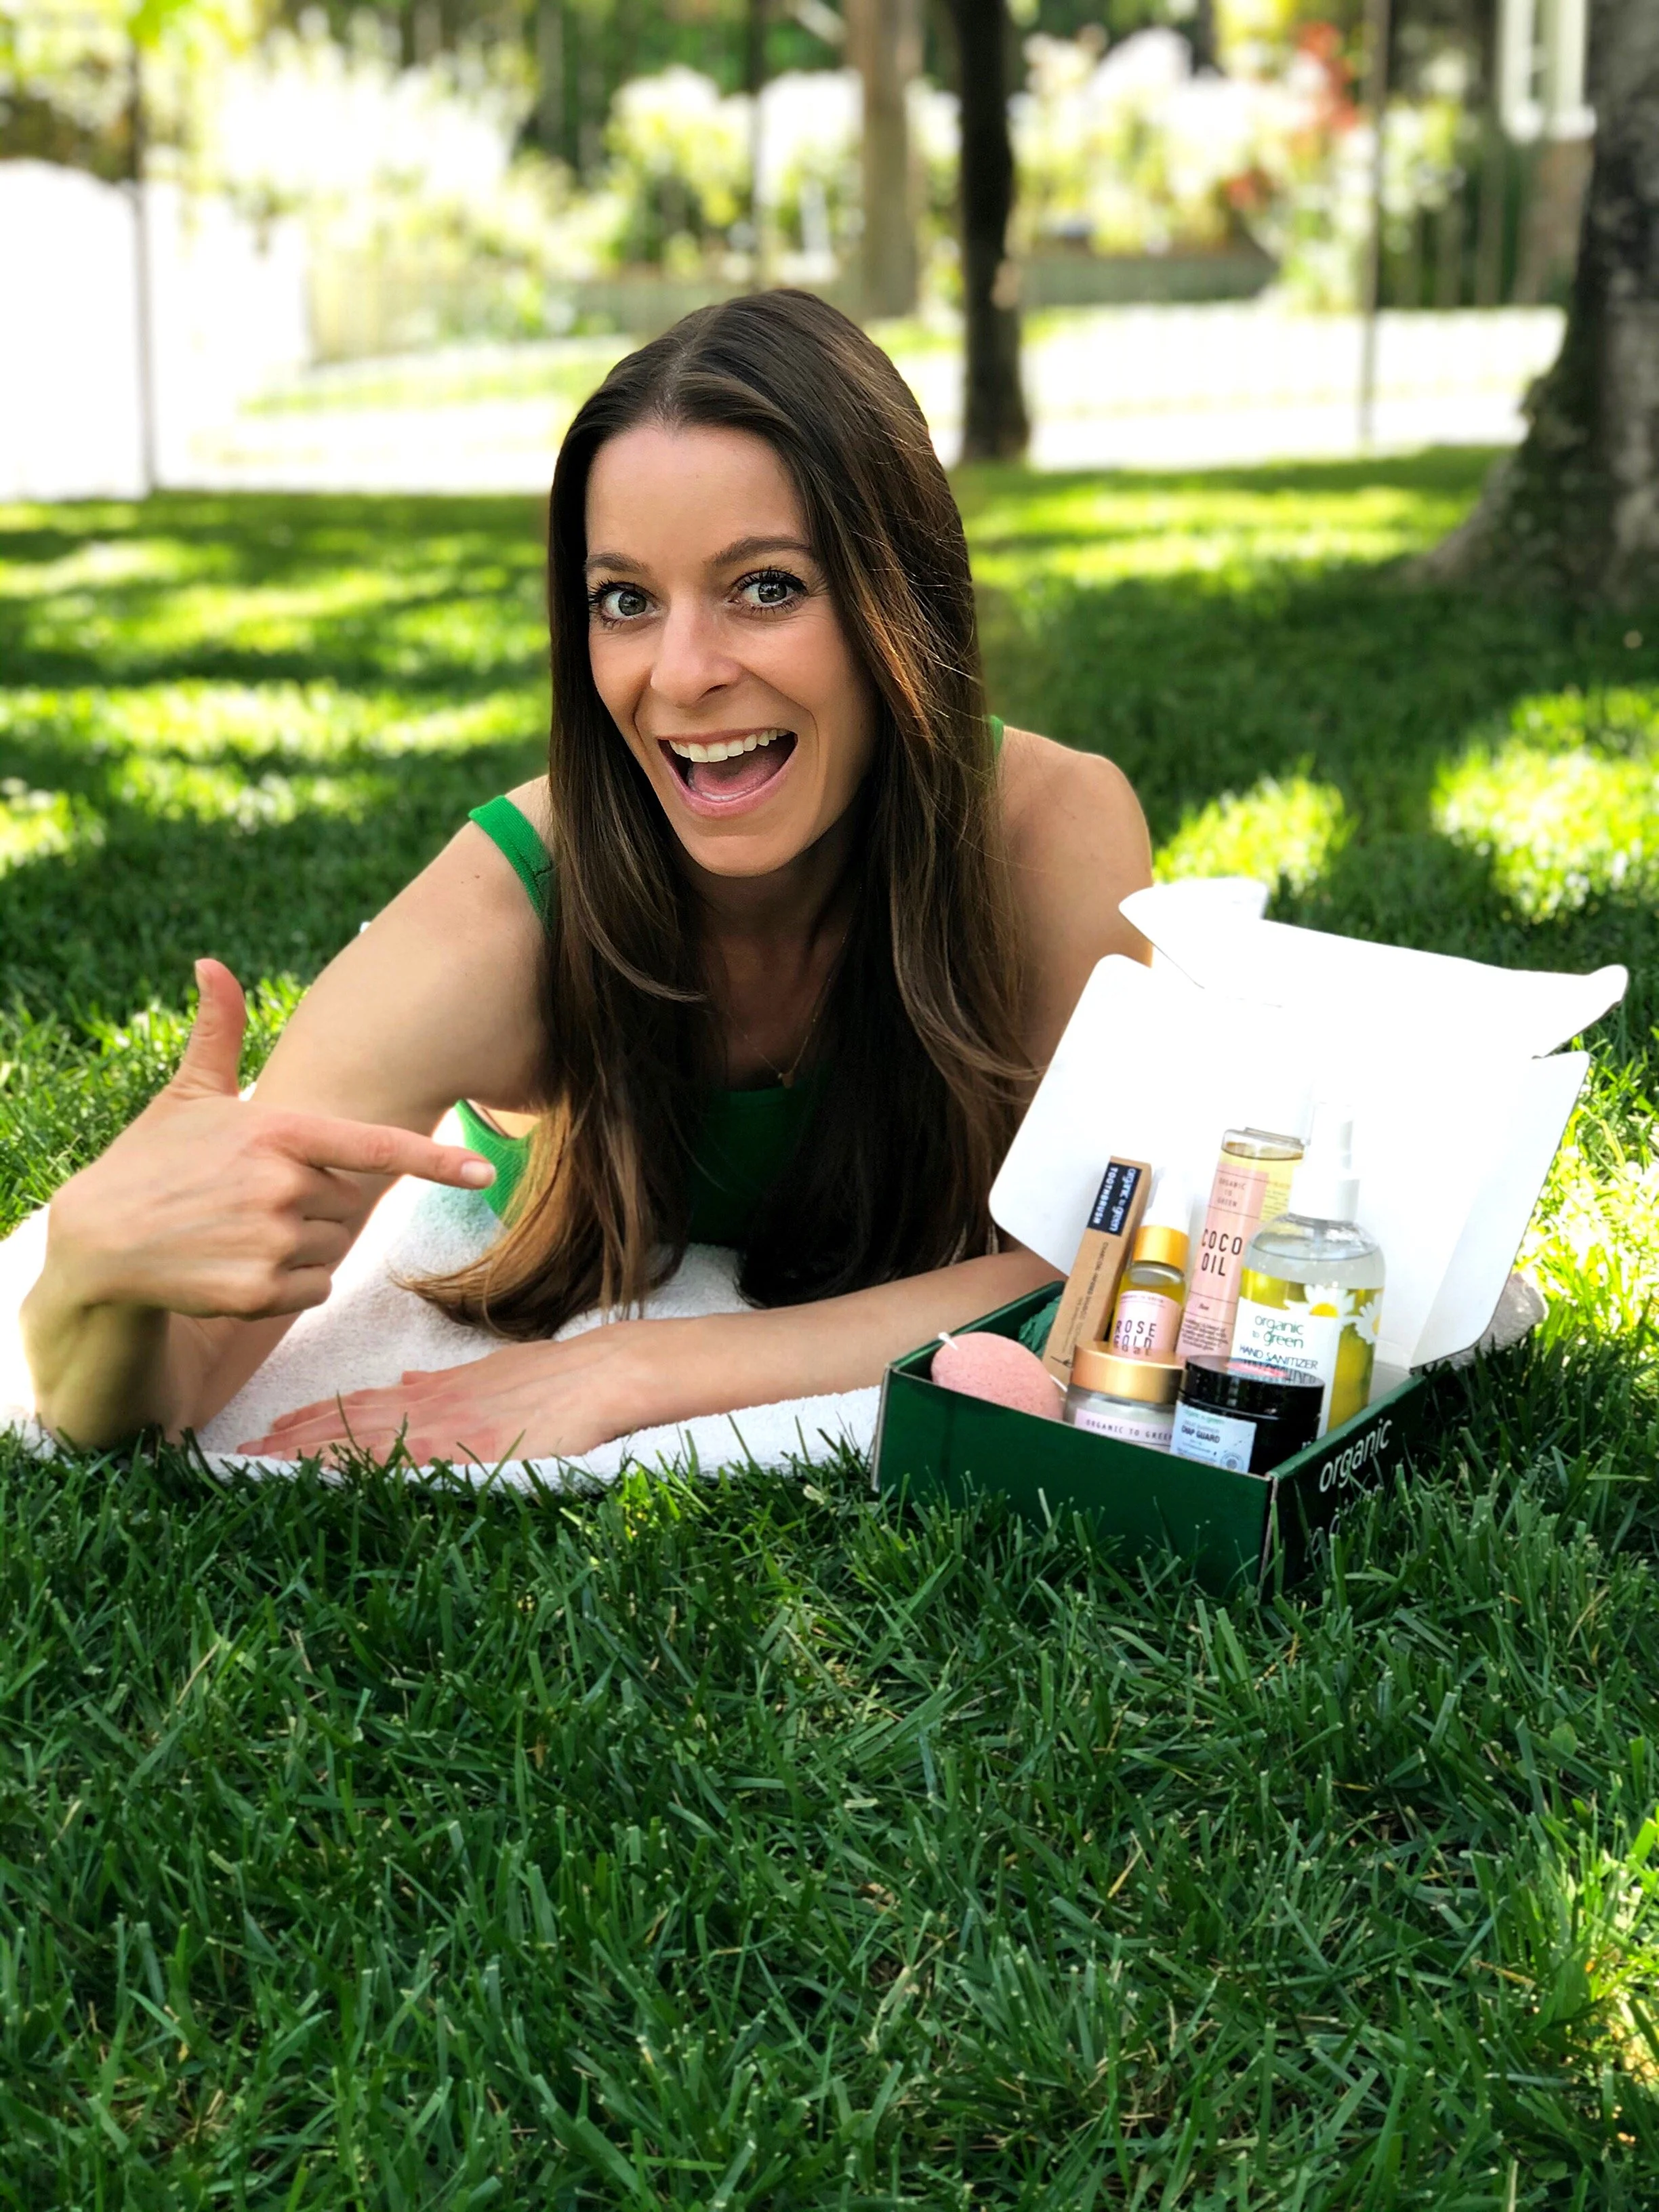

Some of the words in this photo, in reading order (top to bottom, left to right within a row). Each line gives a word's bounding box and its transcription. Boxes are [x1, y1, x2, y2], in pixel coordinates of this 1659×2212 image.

[1218, 1177, 1247, 1190] ORGANIC
[1092, 1166, 1119, 1225] TOOTHBRUSH
[1109, 1206, 1124, 1232] green
[1202, 1228, 1243, 1255] COCO
[1201, 1252, 1226, 1276] OIL
[1114, 1319, 1157, 1338] ROSE
[1254, 1315, 1305, 1335] organic
[1252, 1330, 1260, 1338] to
[1263, 1330, 1304, 1349] green
[1240, 1344, 1264, 1359] HAND
[1265, 1352, 1319, 1370] SANITIZER
[1086, 1418, 1124, 1434] ORGANIC
[1129, 1428, 1140, 1437] TO
[1196, 1429, 1221, 1444] GUARD
[1319, 1418, 1393, 1493] organic
